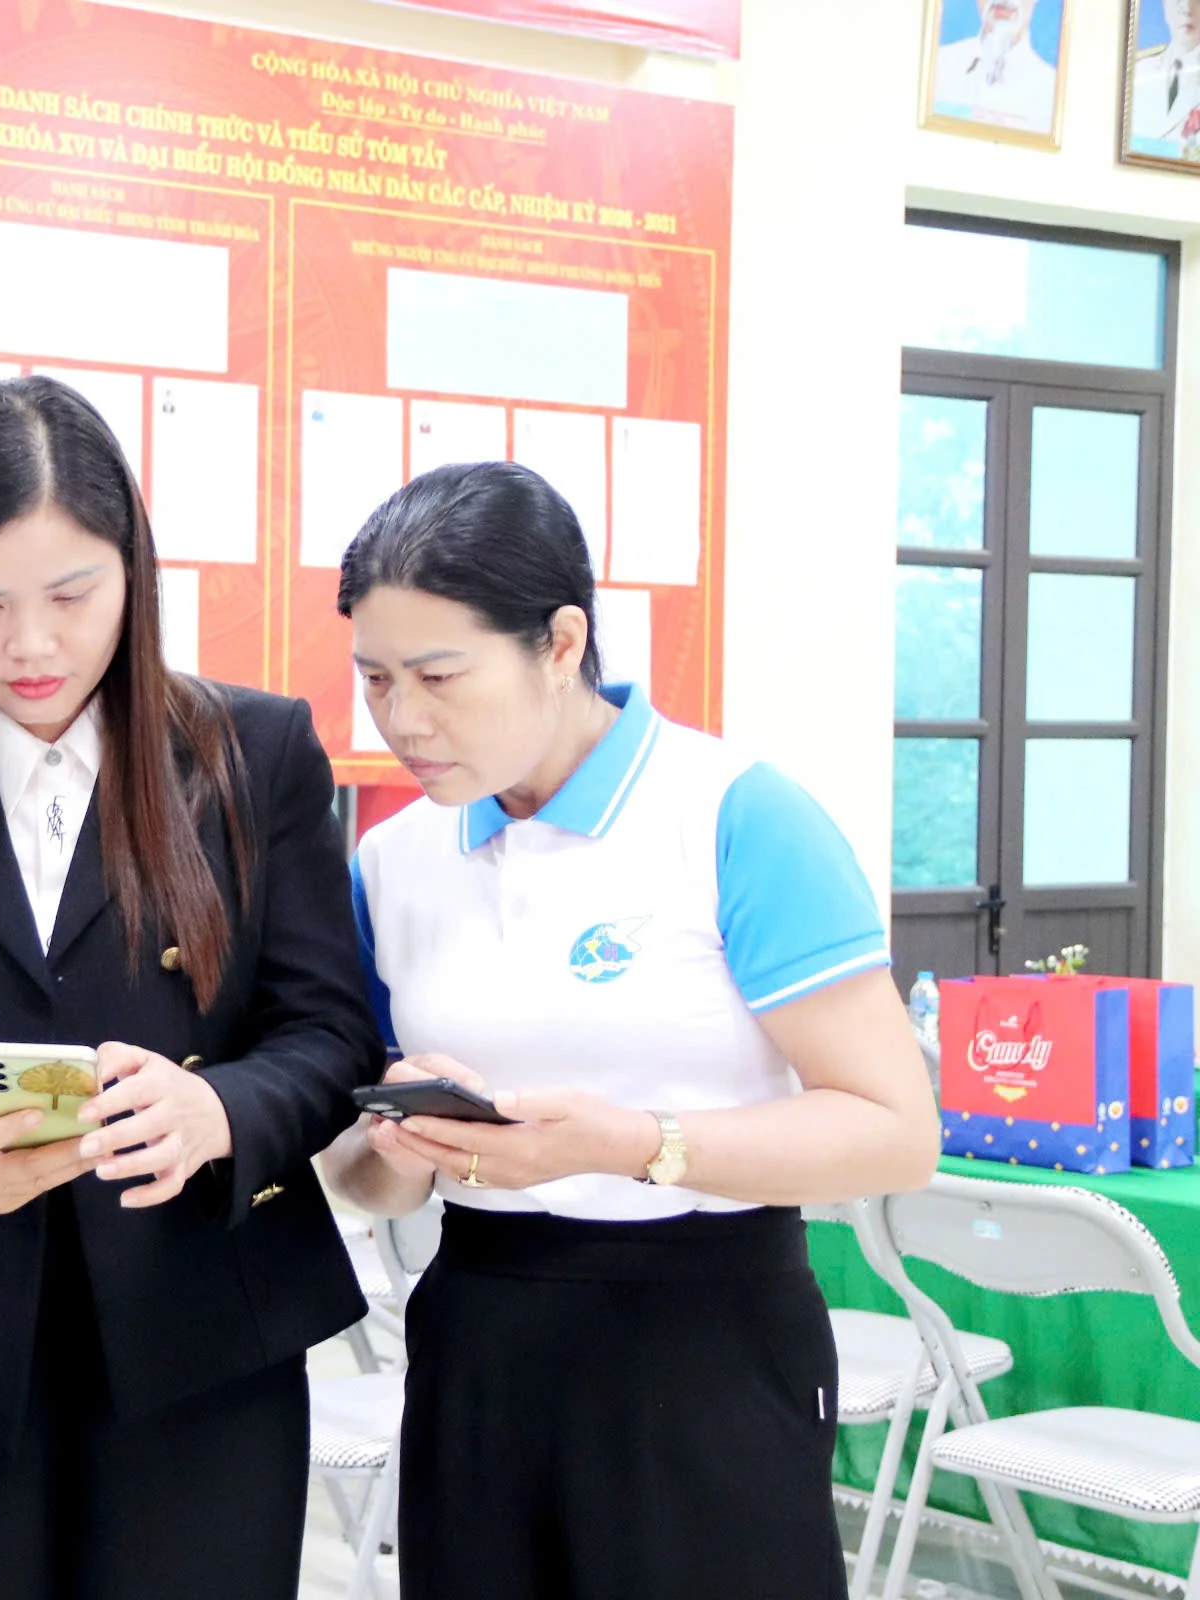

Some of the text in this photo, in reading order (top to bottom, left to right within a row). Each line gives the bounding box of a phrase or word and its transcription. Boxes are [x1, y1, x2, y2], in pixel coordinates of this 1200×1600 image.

[252, 52, 307, 78] CỘNG
[386, 72, 418, 96] HỘI
[424, 77, 461, 102] CHỦ
[466, 84, 523, 110] NGHĨA
[528, 92, 567, 119] VIỆT
[572, 105, 610, 122] NAM
[322, 92, 355, 113] Độc
[358, 97, 385, 121] lập
[398, 103, 423, 126] Tự
[425, 109, 447, 126] do
[460, 114, 503, 138] Hạnh
[0, 87, 59, 116] DANH
[64, 92, 121, 124] SÁCH
[125, 101, 192, 134] CHÍNH
[197, 113, 253, 143] THỨC
[257, 120, 284, 148] VÀ
[288, 121, 333, 153] TIỂU
[337, 130, 363, 157] SỬ
[367, 135, 408, 165] TÓM
[411, 144, 448, 171] TẮT
[58, 134, 95, 160] XVI
[100, 135, 127, 162] VÀ
[131, 143, 168, 172] ĐẠI
[173, 142, 221, 175] BIỂU
[226, 155, 263, 184] HỘI
[268, 155, 323, 189] ĐỒNG
[328, 167, 380, 195] NHÂN
[385, 174, 424, 202] DÂN
[428, 178, 465, 208] CÁC
[511, 193, 568, 224] NHIỆM
